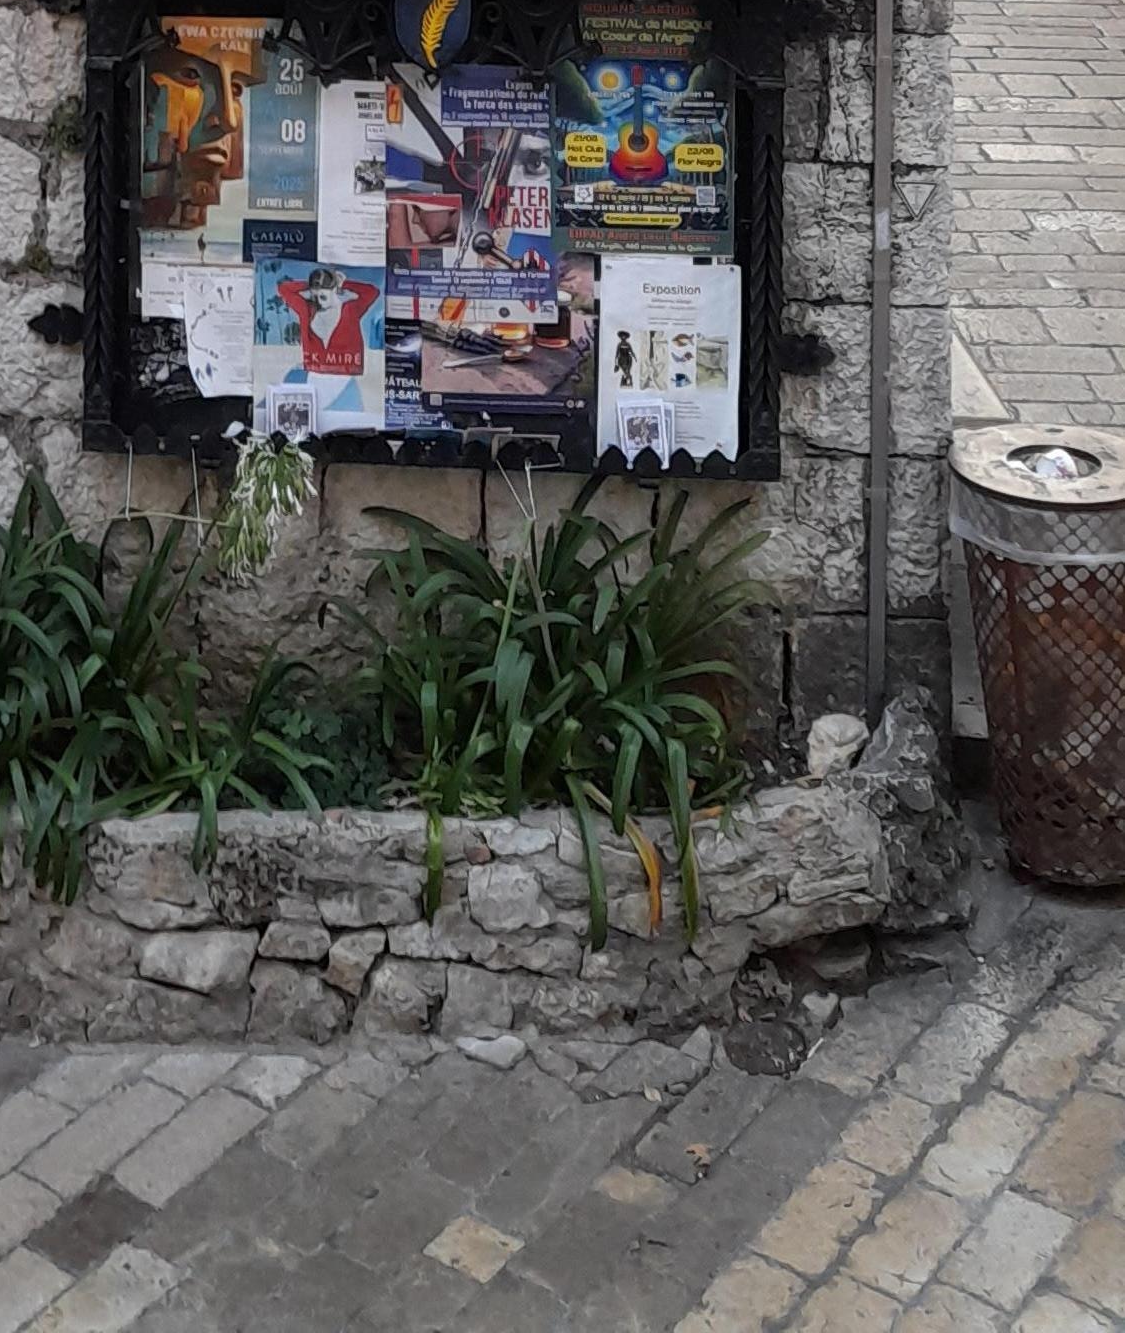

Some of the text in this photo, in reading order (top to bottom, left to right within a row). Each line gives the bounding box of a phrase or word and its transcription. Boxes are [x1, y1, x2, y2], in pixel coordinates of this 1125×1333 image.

[584, 17, 644, 30] FESTIVAL
[662, 19, 713, 33] MUSIQUE
[449, 86, 515, 100] Fragmentations
[463, 100, 472, 110] la
[473, 99, 495, 110] force
[497, 100, 513, 111] des
[281, 118, 306, 143] 08
[494, 185, 549, 208] PETER
[487, 207, 552, 230] KLASEN
[642, 283, 701, 296] Exposition
